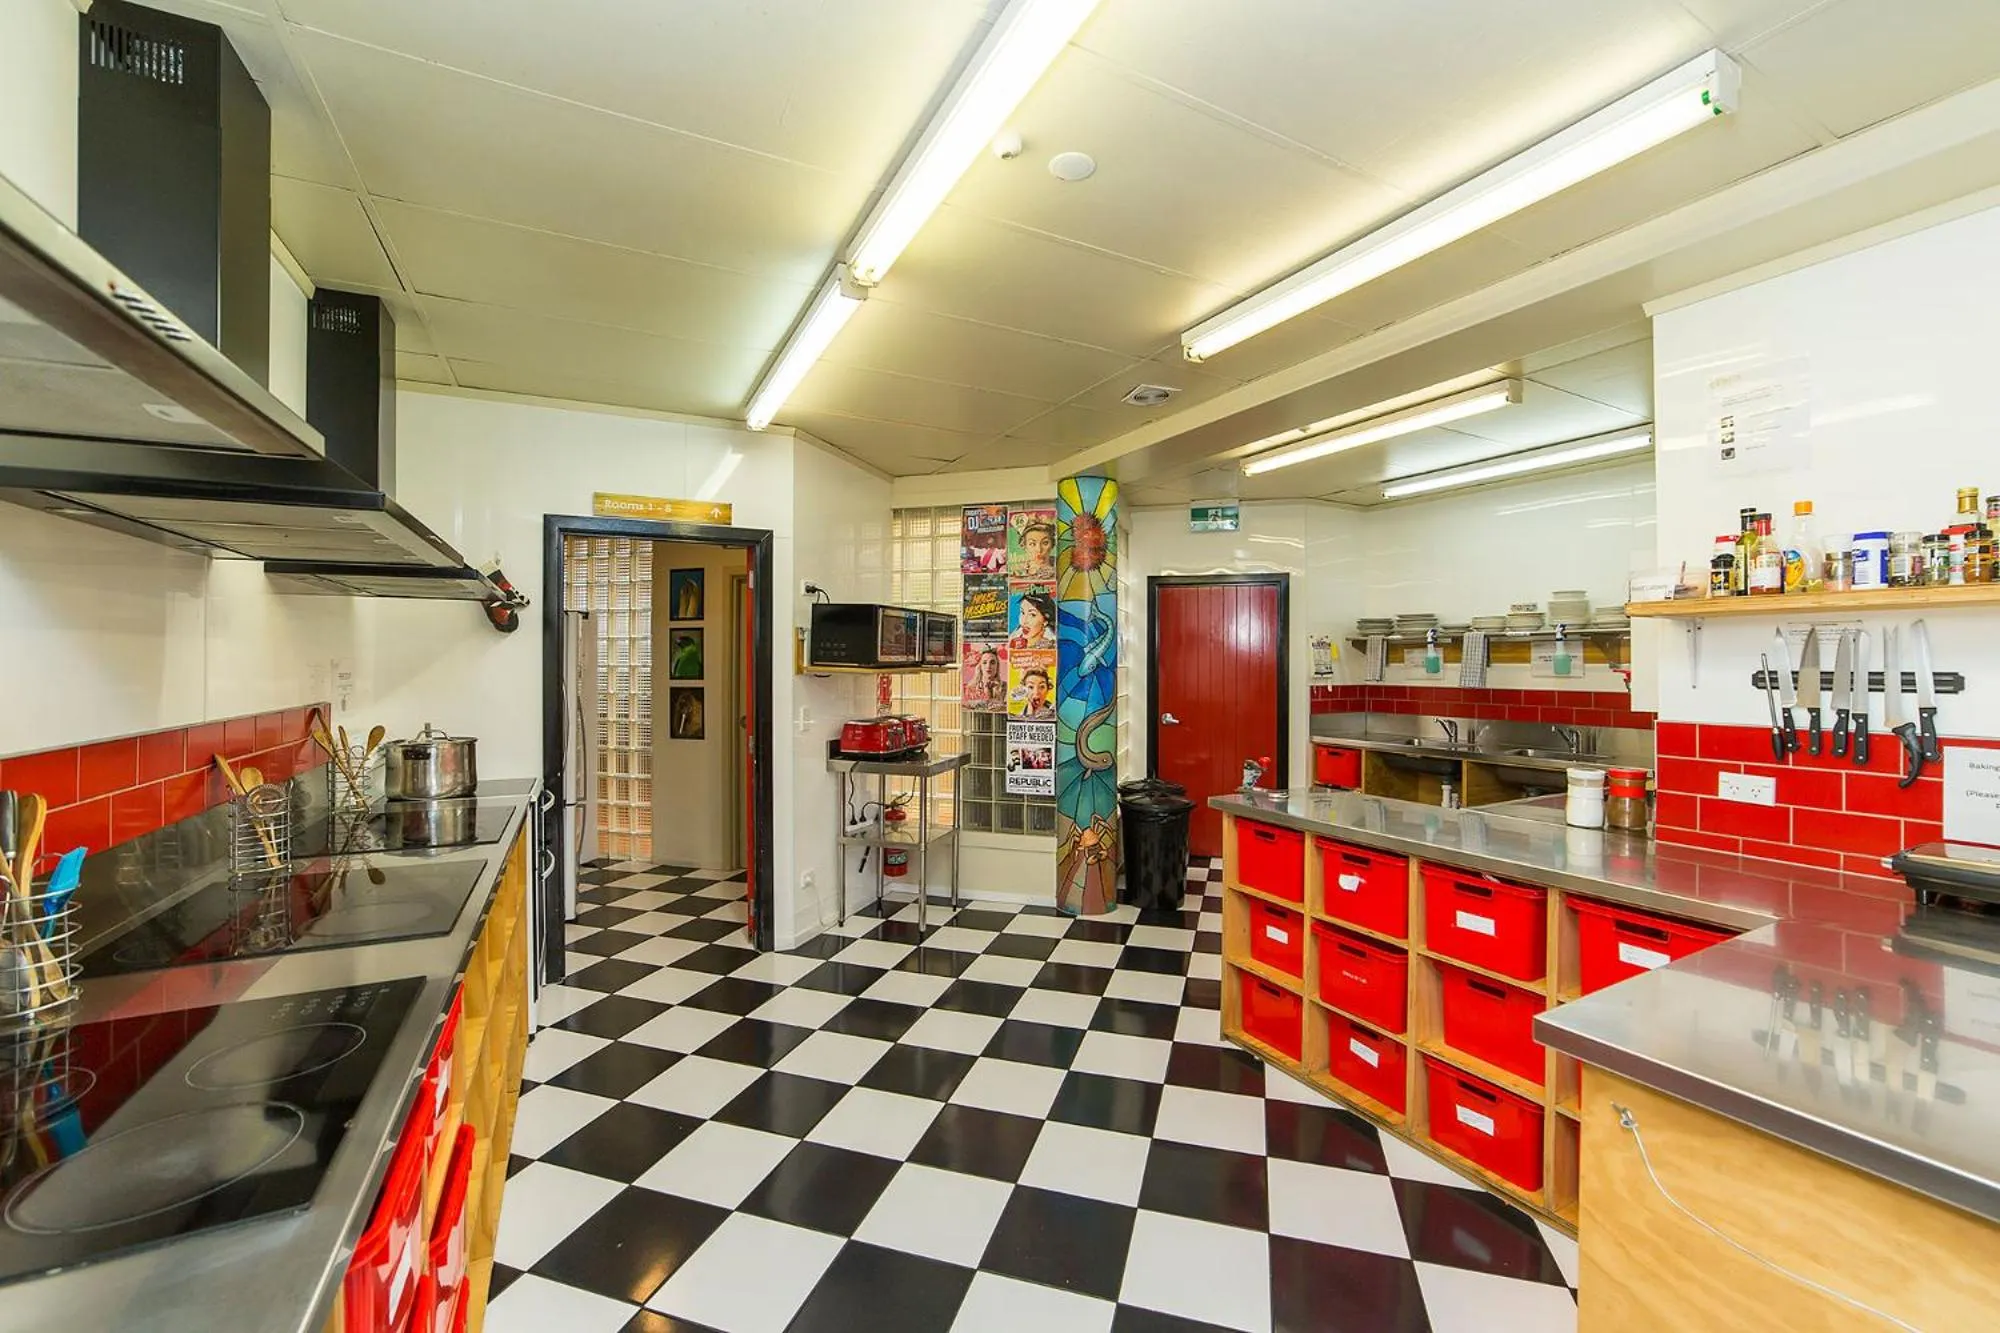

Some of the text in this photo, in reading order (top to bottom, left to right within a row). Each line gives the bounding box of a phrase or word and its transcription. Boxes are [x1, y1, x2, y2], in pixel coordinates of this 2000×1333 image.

[604, 499, 644, 511] Rooms
[1008, 724, 1053, 734] FRONT OF HOUSE
[1008, 731, 1054, 742] STAFF NEEDED
[1008, 776, 1052, 788] REPUBLIC
